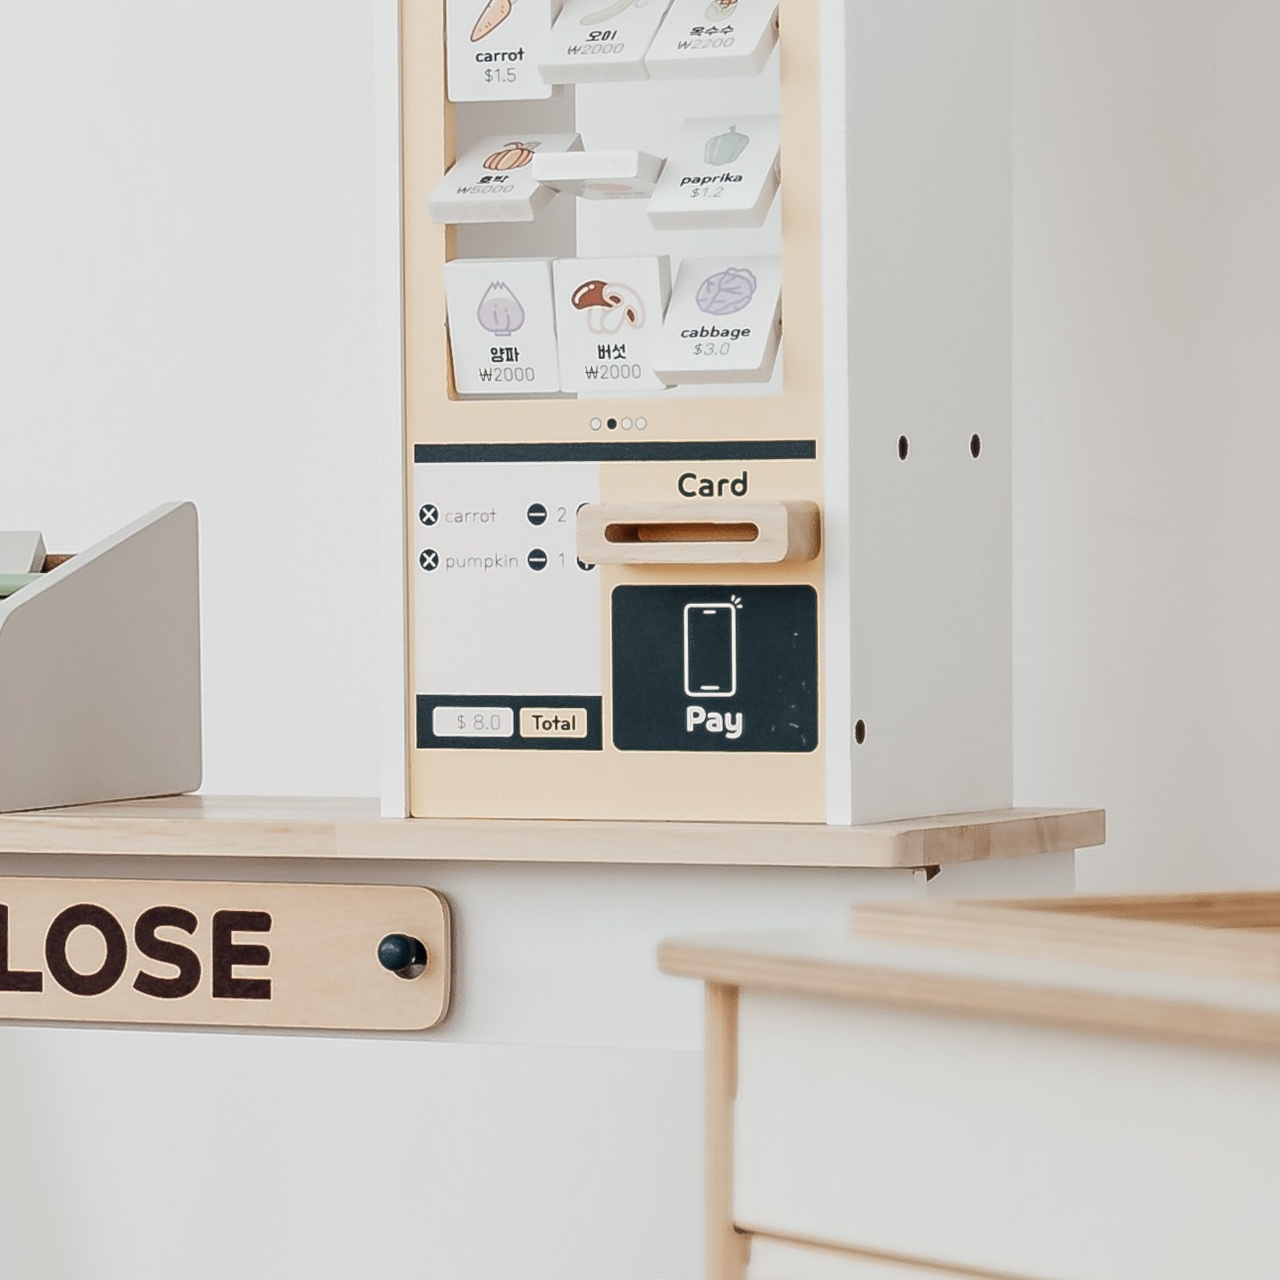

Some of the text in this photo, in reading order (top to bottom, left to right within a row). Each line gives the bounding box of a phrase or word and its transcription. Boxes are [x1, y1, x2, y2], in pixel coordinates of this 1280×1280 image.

[585, 30, 618, 43] 오이
[689, 25, 735, 37] 옥수수
[475, 47, 525, 63] carrot
[484, 67, 517, 84] $1.5
[679, 172, 744, 187] paprika
[689, 186, 724, 199] $1.2
[680, 325, 752, 341] cabbage
[489, 346, 520, 363] 양파
[596, 343, 627, 361] 버섯
[693, 342, 731, 357] $3.0
[677, 471, 748, 498] Card
[444, 507, 567, 523] carrot 2
[444, 552, 519, 571] pumpkin
[531, 714, 577, 732] Total
[685, 705, 744, 740] Pay
